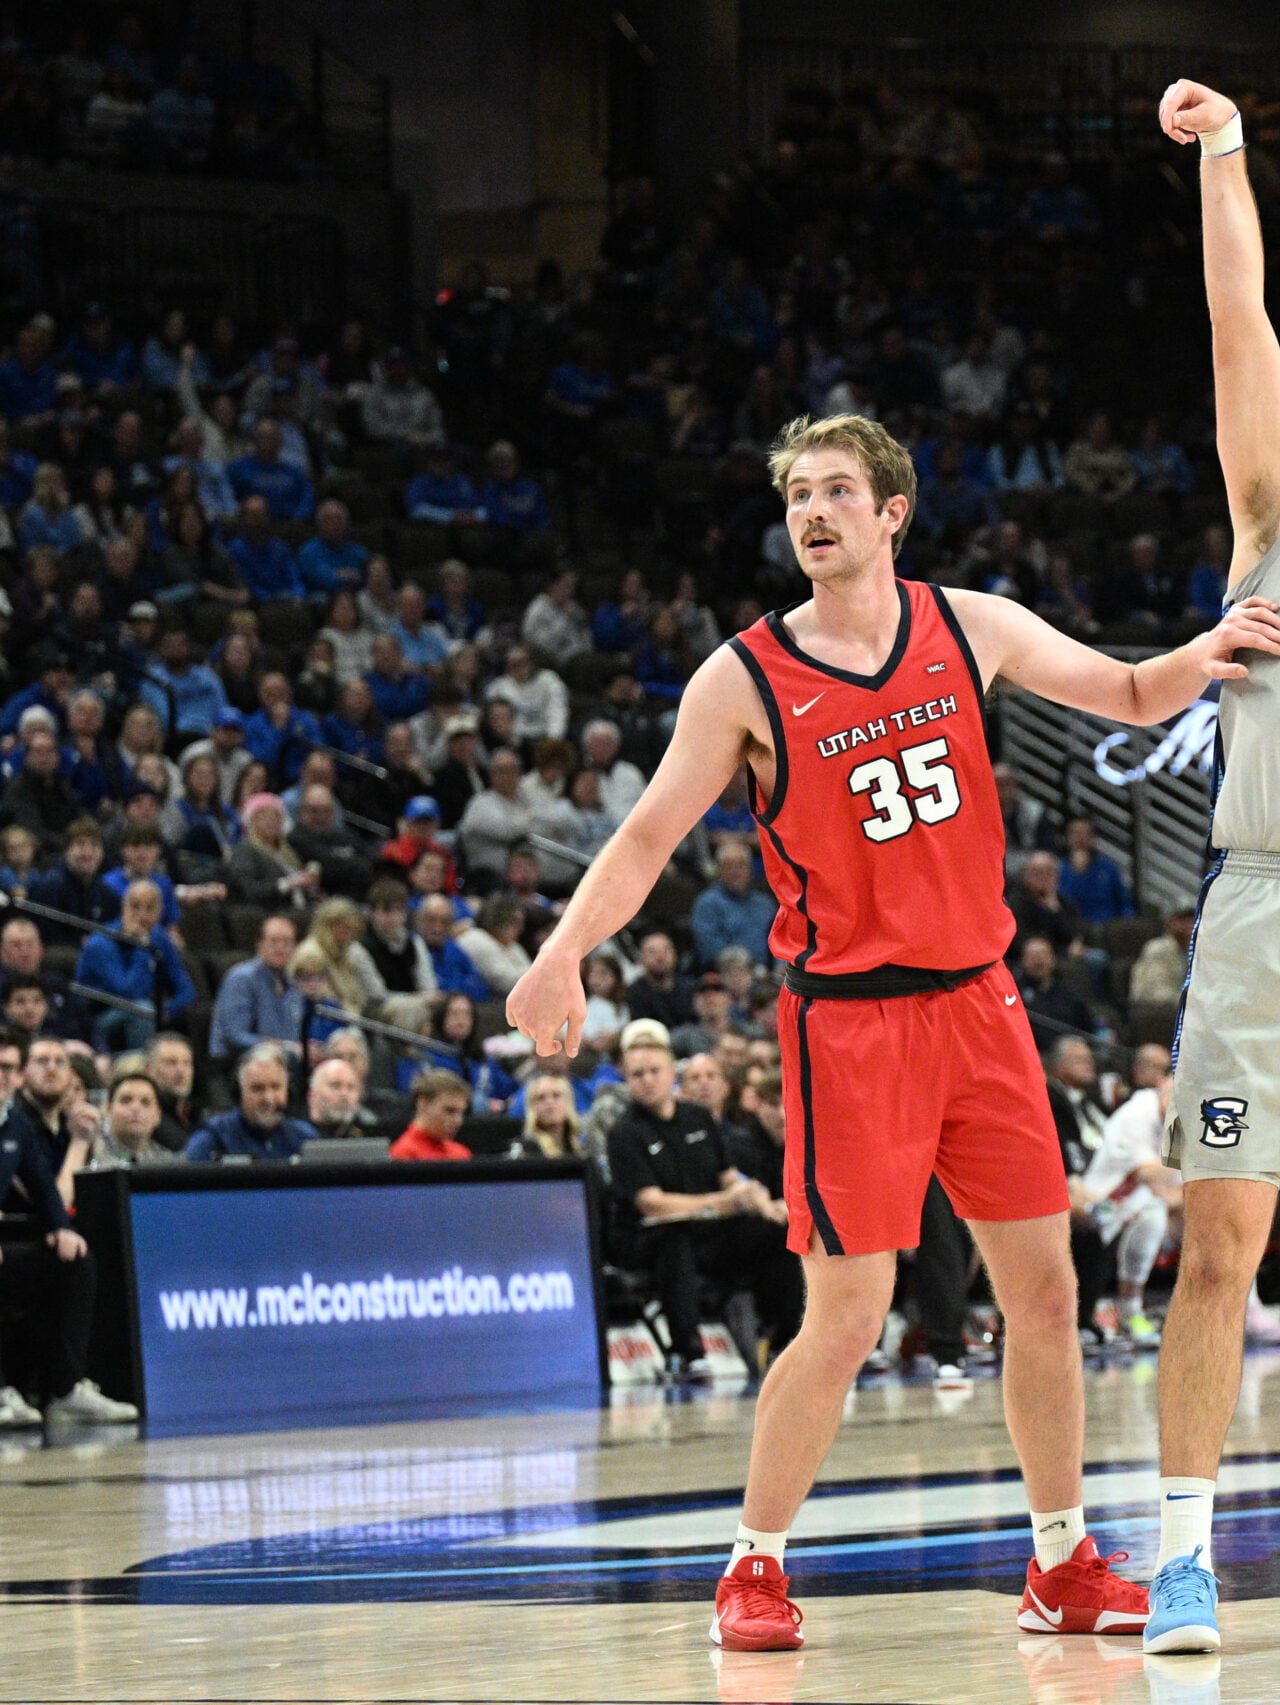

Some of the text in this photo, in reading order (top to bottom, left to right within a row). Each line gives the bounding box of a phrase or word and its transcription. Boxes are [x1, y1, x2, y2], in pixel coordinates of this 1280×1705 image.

[926, 662, 946, 674] WAC
[817, 693, 958, 759] UTAH TECH
[847, 736, 962, 845] 35
[158, 1264, 576, 1332] www.mclconstruction.com
